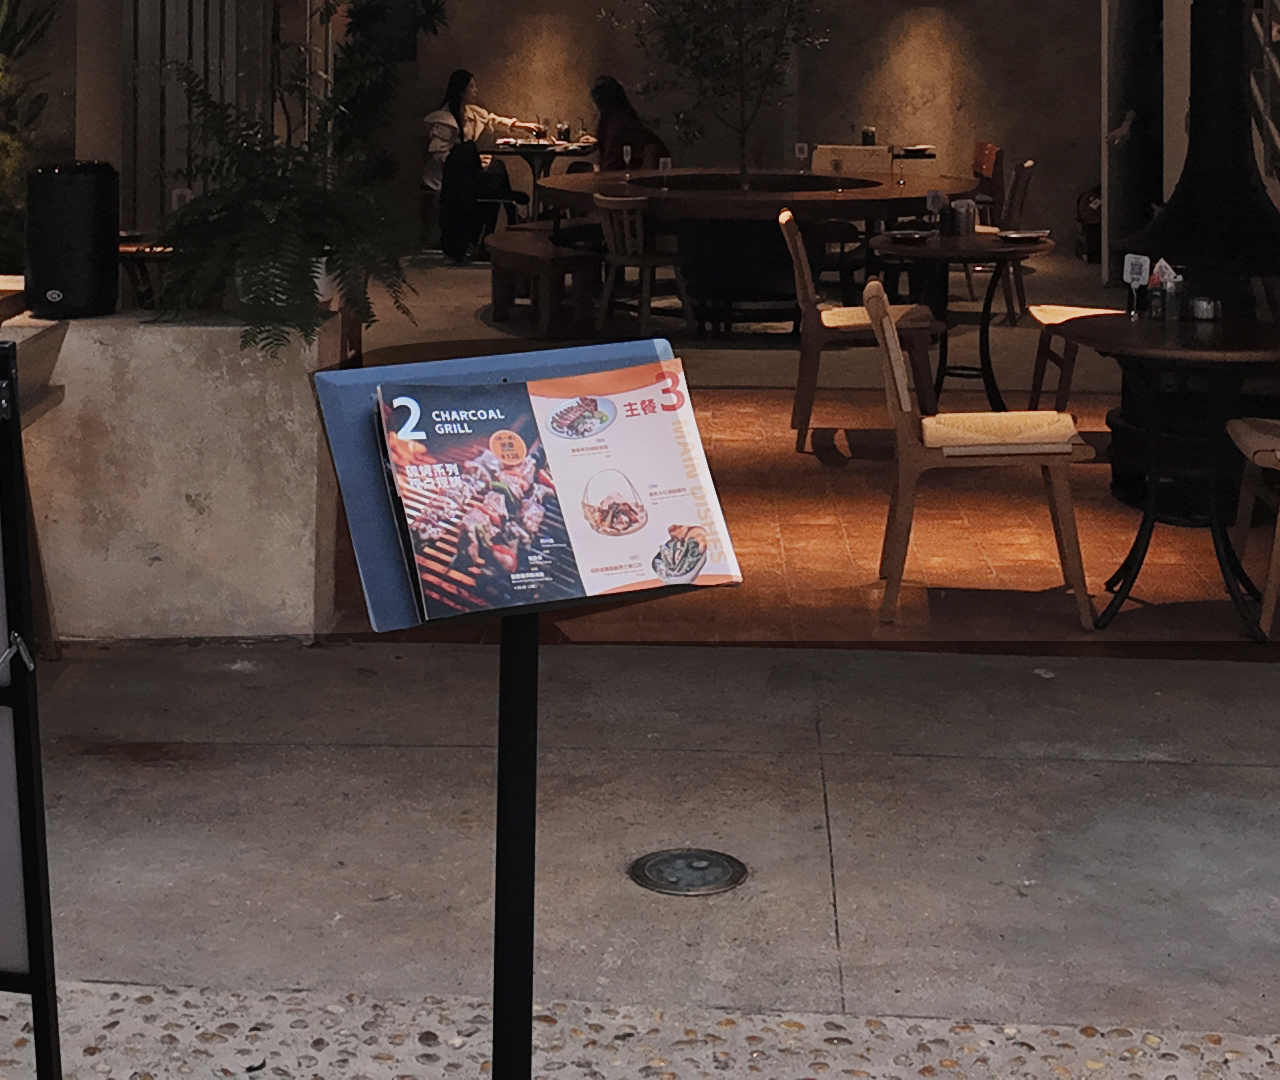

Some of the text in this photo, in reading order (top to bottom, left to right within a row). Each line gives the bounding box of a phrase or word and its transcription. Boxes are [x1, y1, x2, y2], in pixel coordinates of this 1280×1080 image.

[623, 371, 685, 418] 主餐 3
[392, 396, 505, 440] 2 CHARCOAL
[435, 423, 473, 434] GRILL
